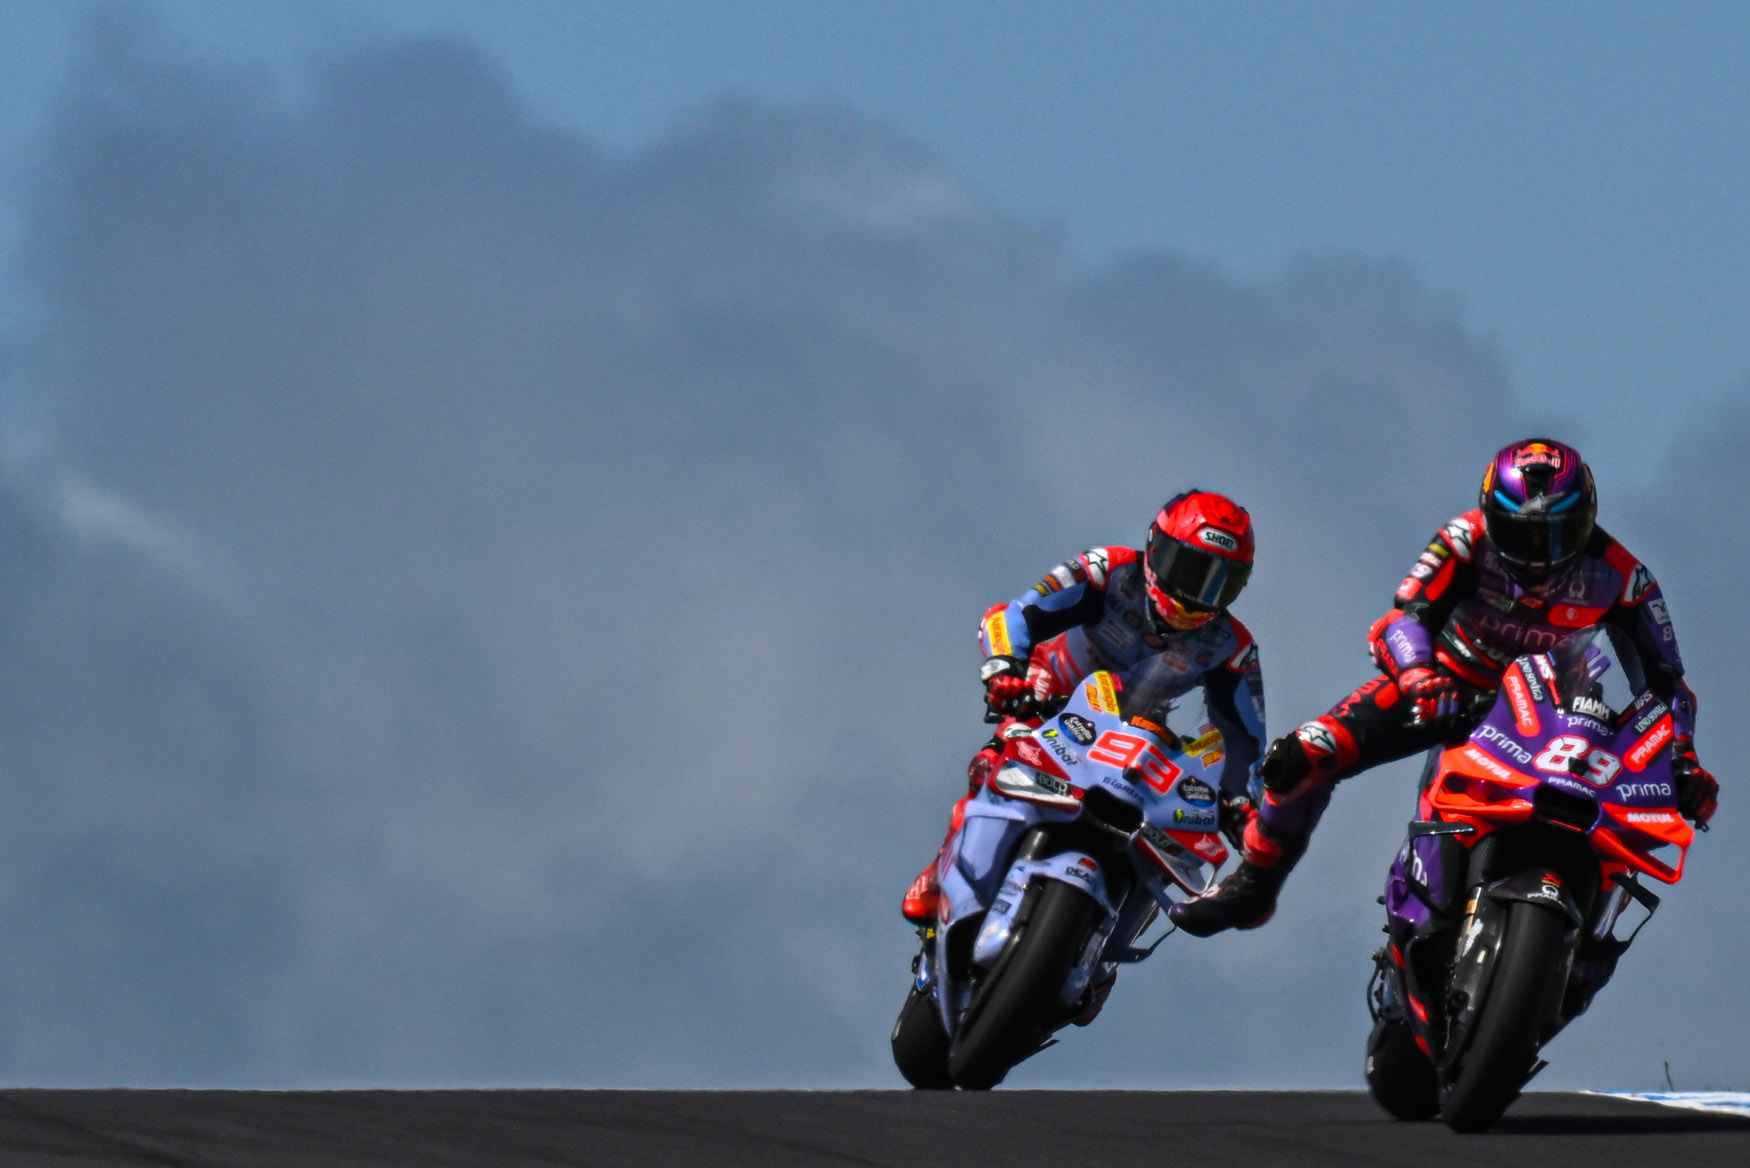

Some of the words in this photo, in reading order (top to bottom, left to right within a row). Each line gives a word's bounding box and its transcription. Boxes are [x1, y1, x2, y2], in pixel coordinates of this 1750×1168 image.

[1507, 676, 1533, 726] PRAMAC
[1572, 696, 1610, 720] FIAMM
[1567, 716, 1608, 736] prima
[1041, 729, 1079, 766] Unibat
[1478, 725, 1532, 764] prima
[1630, 725, 1671, 763] PRAMAC
[1087, 730, 1183, 794] 93
[1465, 749, 1512, 780] MOTUL
[1533, 735, 1623, 789] 89
[1548, 776, 1596, 798] PRAMAC
[1616, 782, 1671, 802] prima
[1627, 812, 1675, 823] MOTUL
